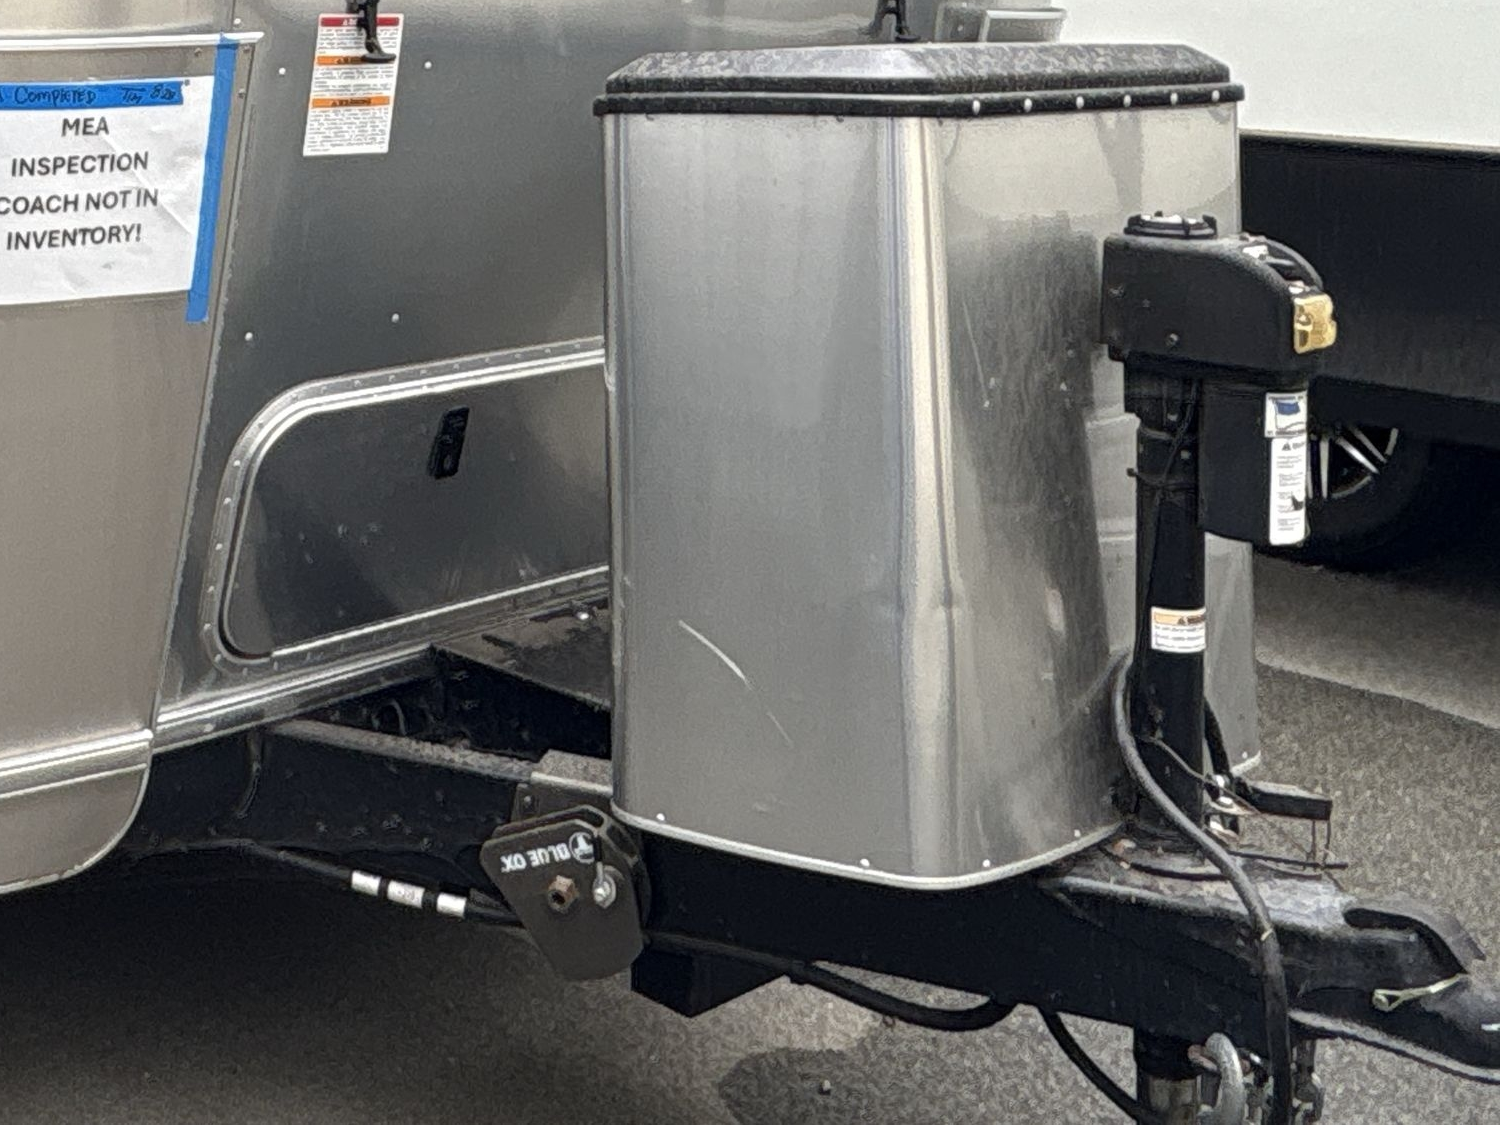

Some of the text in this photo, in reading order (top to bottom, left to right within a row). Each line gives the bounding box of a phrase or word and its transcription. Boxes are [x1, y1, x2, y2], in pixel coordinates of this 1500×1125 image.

[61, 117, 110, 137] MEA
[11, 152, 149, 178] INSPECTION
[85, 190, 133, 211] NOT
[135, 188, 159, 209] IN
[6, 223, 142, 251] INVENTORY!
[501, 842, 571, 873] BLUE OX
